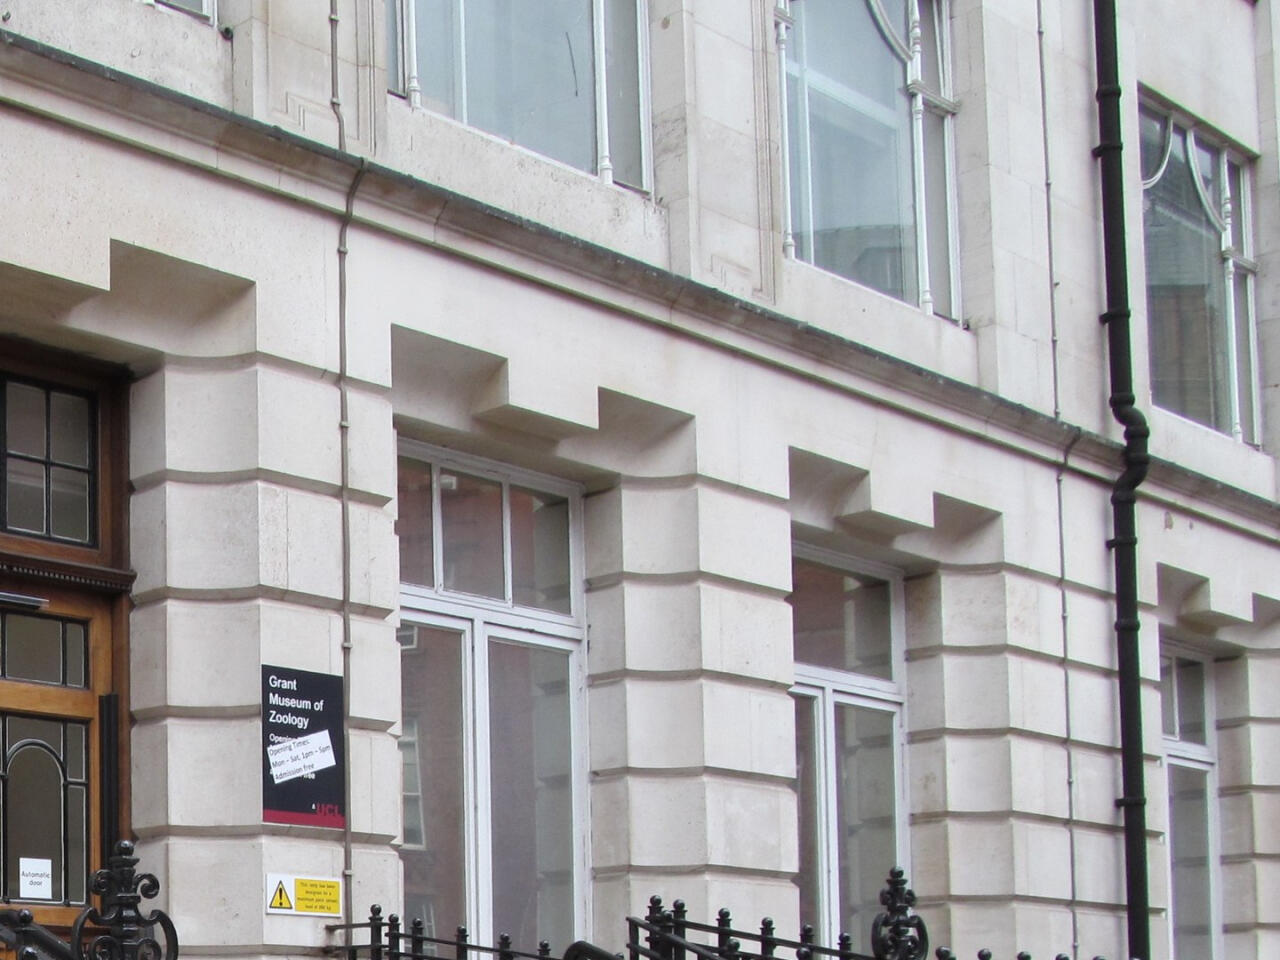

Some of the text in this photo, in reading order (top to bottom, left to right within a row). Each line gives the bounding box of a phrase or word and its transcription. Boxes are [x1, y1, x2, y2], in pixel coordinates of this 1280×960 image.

[269, 675, 297, 691] Grant
[269, 693, 324, 711] Museum of
[269, 711, 309, 729] Zoology
[269, 743, 293, 757] Opening
[272, 759, 285, 768] Mon
[275, 763, 315, 780] Admission free
[21, 870, 51, 880] Automatic
[28, 879, 43, 887] door
